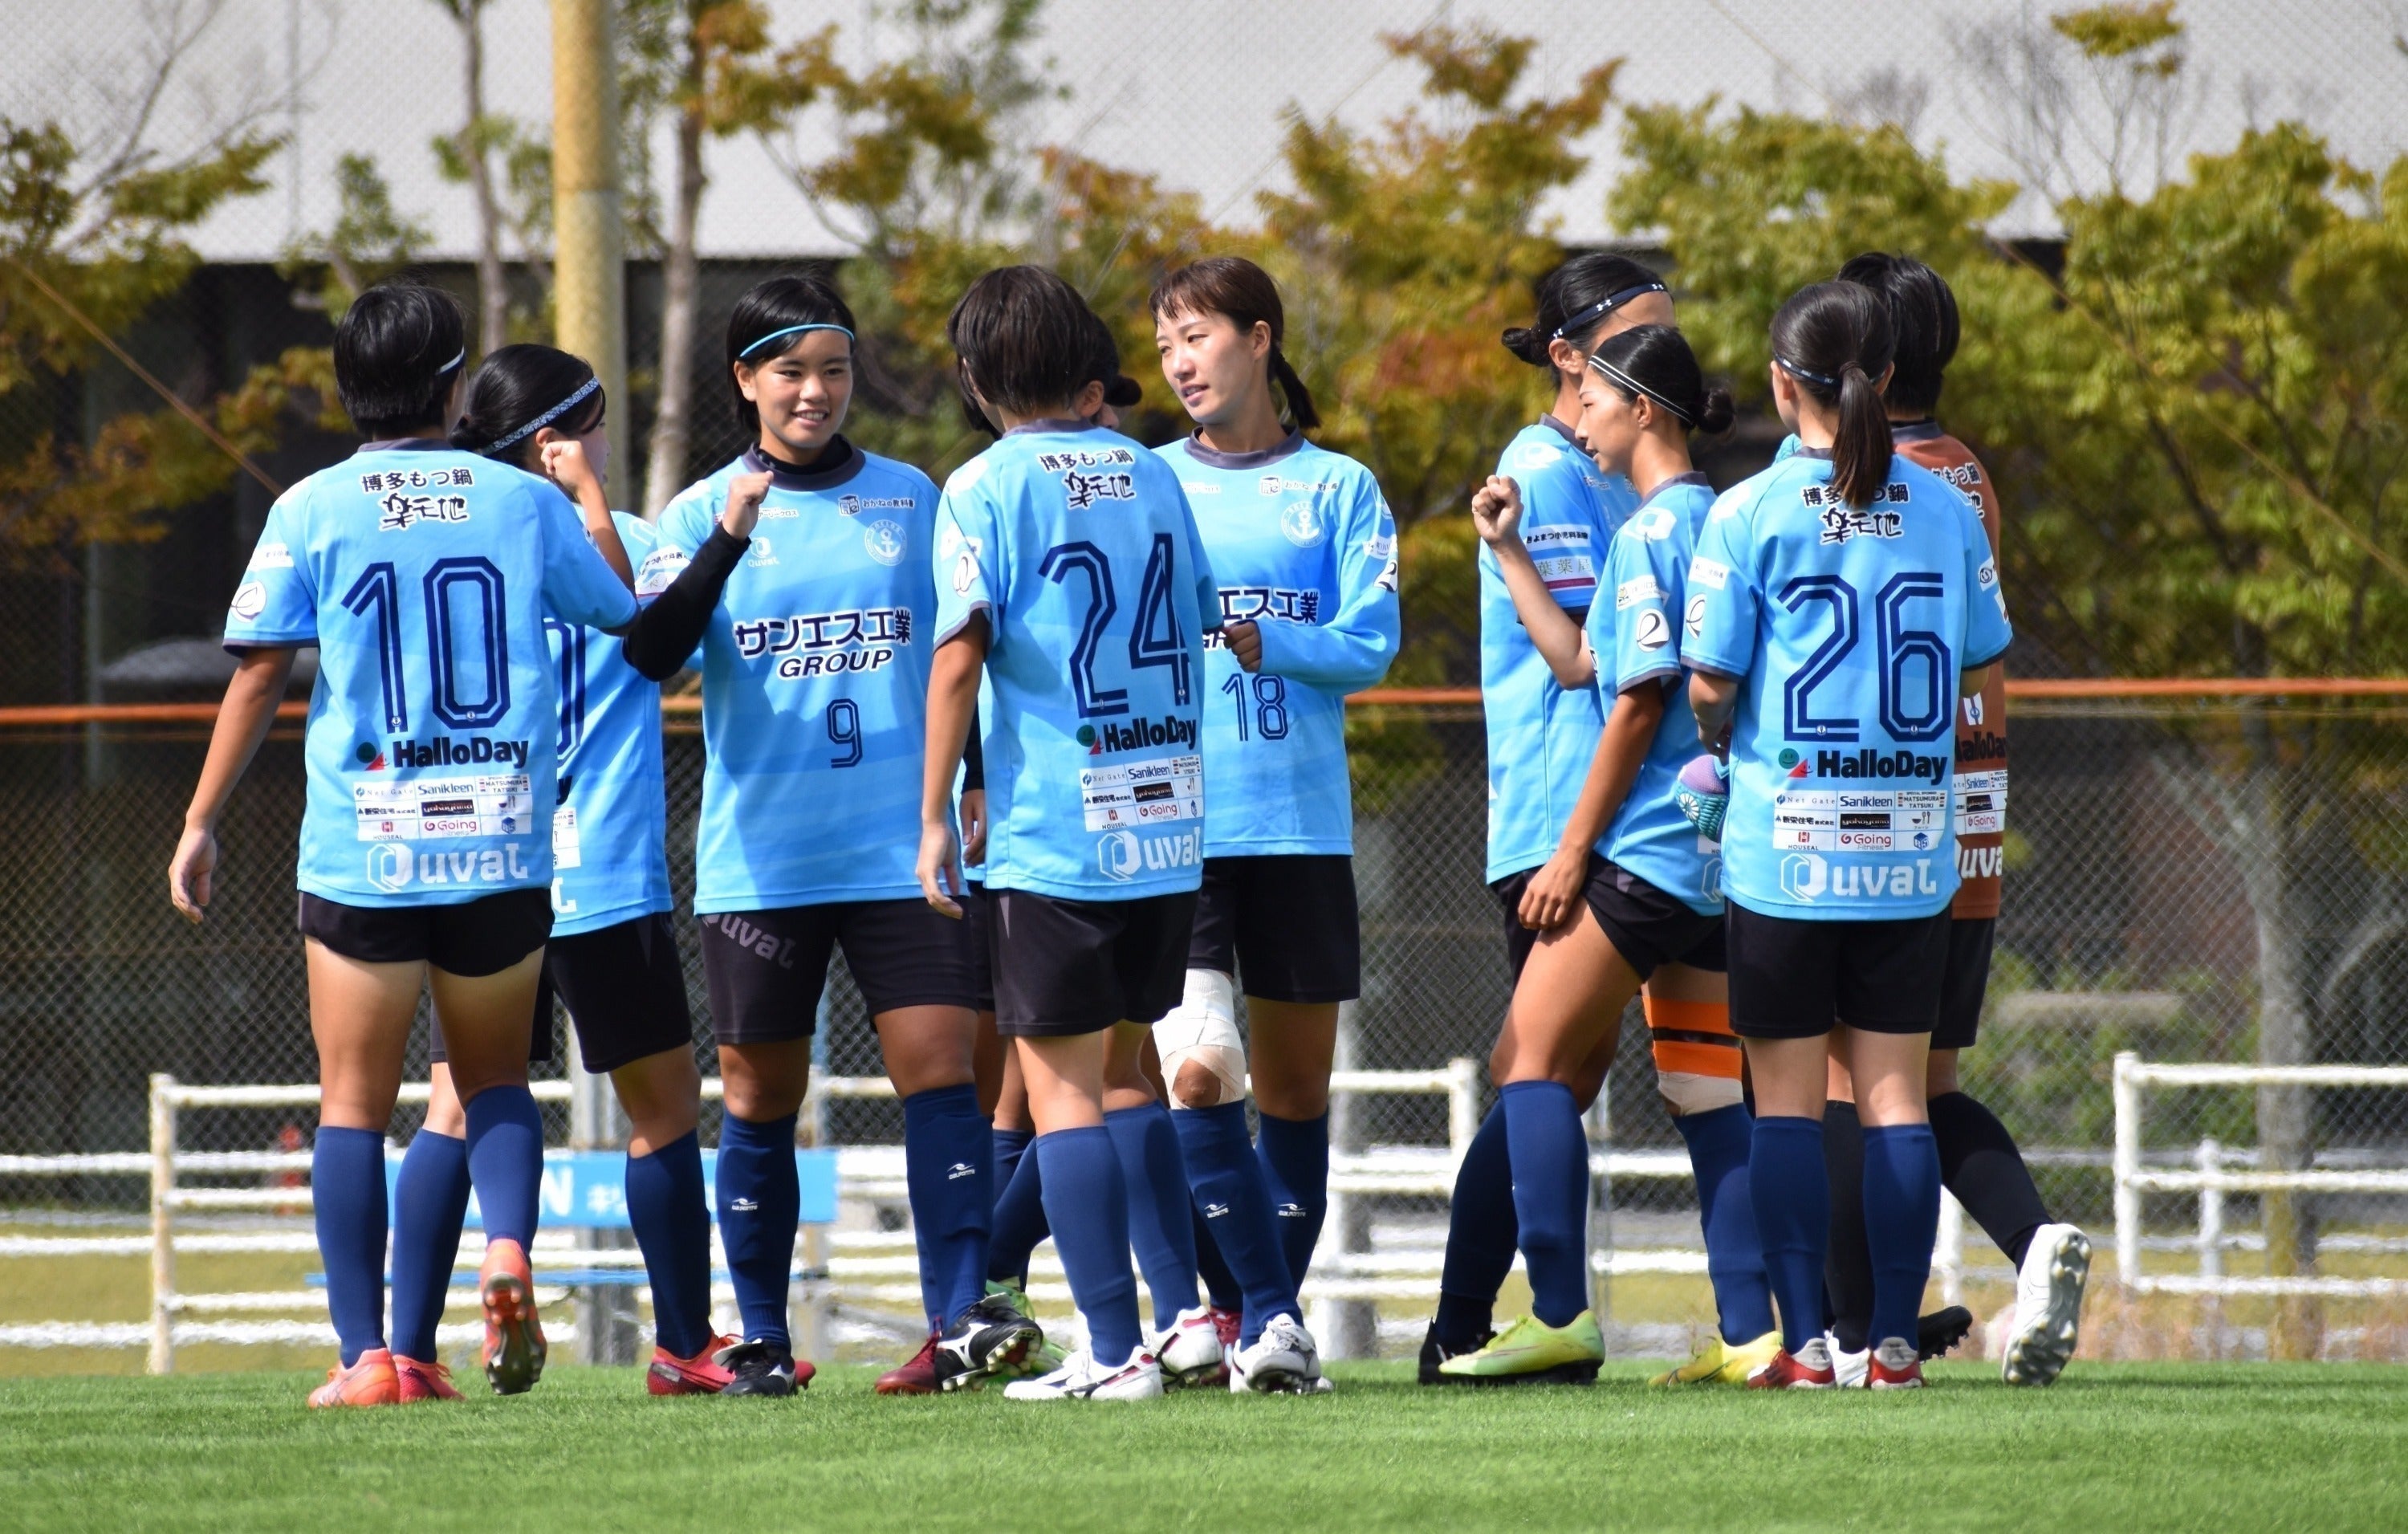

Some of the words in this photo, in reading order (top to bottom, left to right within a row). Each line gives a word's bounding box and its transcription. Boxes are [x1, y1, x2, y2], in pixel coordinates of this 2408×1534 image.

[1039, 450, 1133, 471] 博多もつ鍋
[1932, 464, 1981, 485] もつ鍋
[361, 468, 474, 492] 博多もつ鍋
[1064, 472, 1135, 507] 楽天地
[1803, 483, 1910, 507] 博多つ鍋
[381, 492, 468, 530] 楽天地
[863, 498, 914, 508] おかねの教科書
[1821, 507, 1902, 544] 楽天地
[1218, 588, 1320, 624] エス工業
[735, 608, 911, 657] サンエス工業
[1038, 533, 1191, 719] 24
[340, 555, 511, 734] 10
[1777, 572, 1952, 743] 26
[779, 649, 893, 678] GROUP
[1221, 673, 1289, 742] 18
[826, 698, 863, 769] 9
[1103, 715, 1197, 753] HalloDay
[1954, 730, 2006, 763] alloDa
[393, 736, 529, 769] HalloDay
[1817, 749, 1949, 786] HalloDay
[1129, 765, 1170, 780] Sanikleen
[418, 783, 474, 796] Sanikleen
[1840, 795, 1893, 808] Sanikleen
[437, 819, 478, 832] Going
[1149, 804, 1178, 817] Going
[1974, 815, 1995, 828] Going
[1853, 834, 1892, 848] Going
[702, 913, 797, 970] uval
